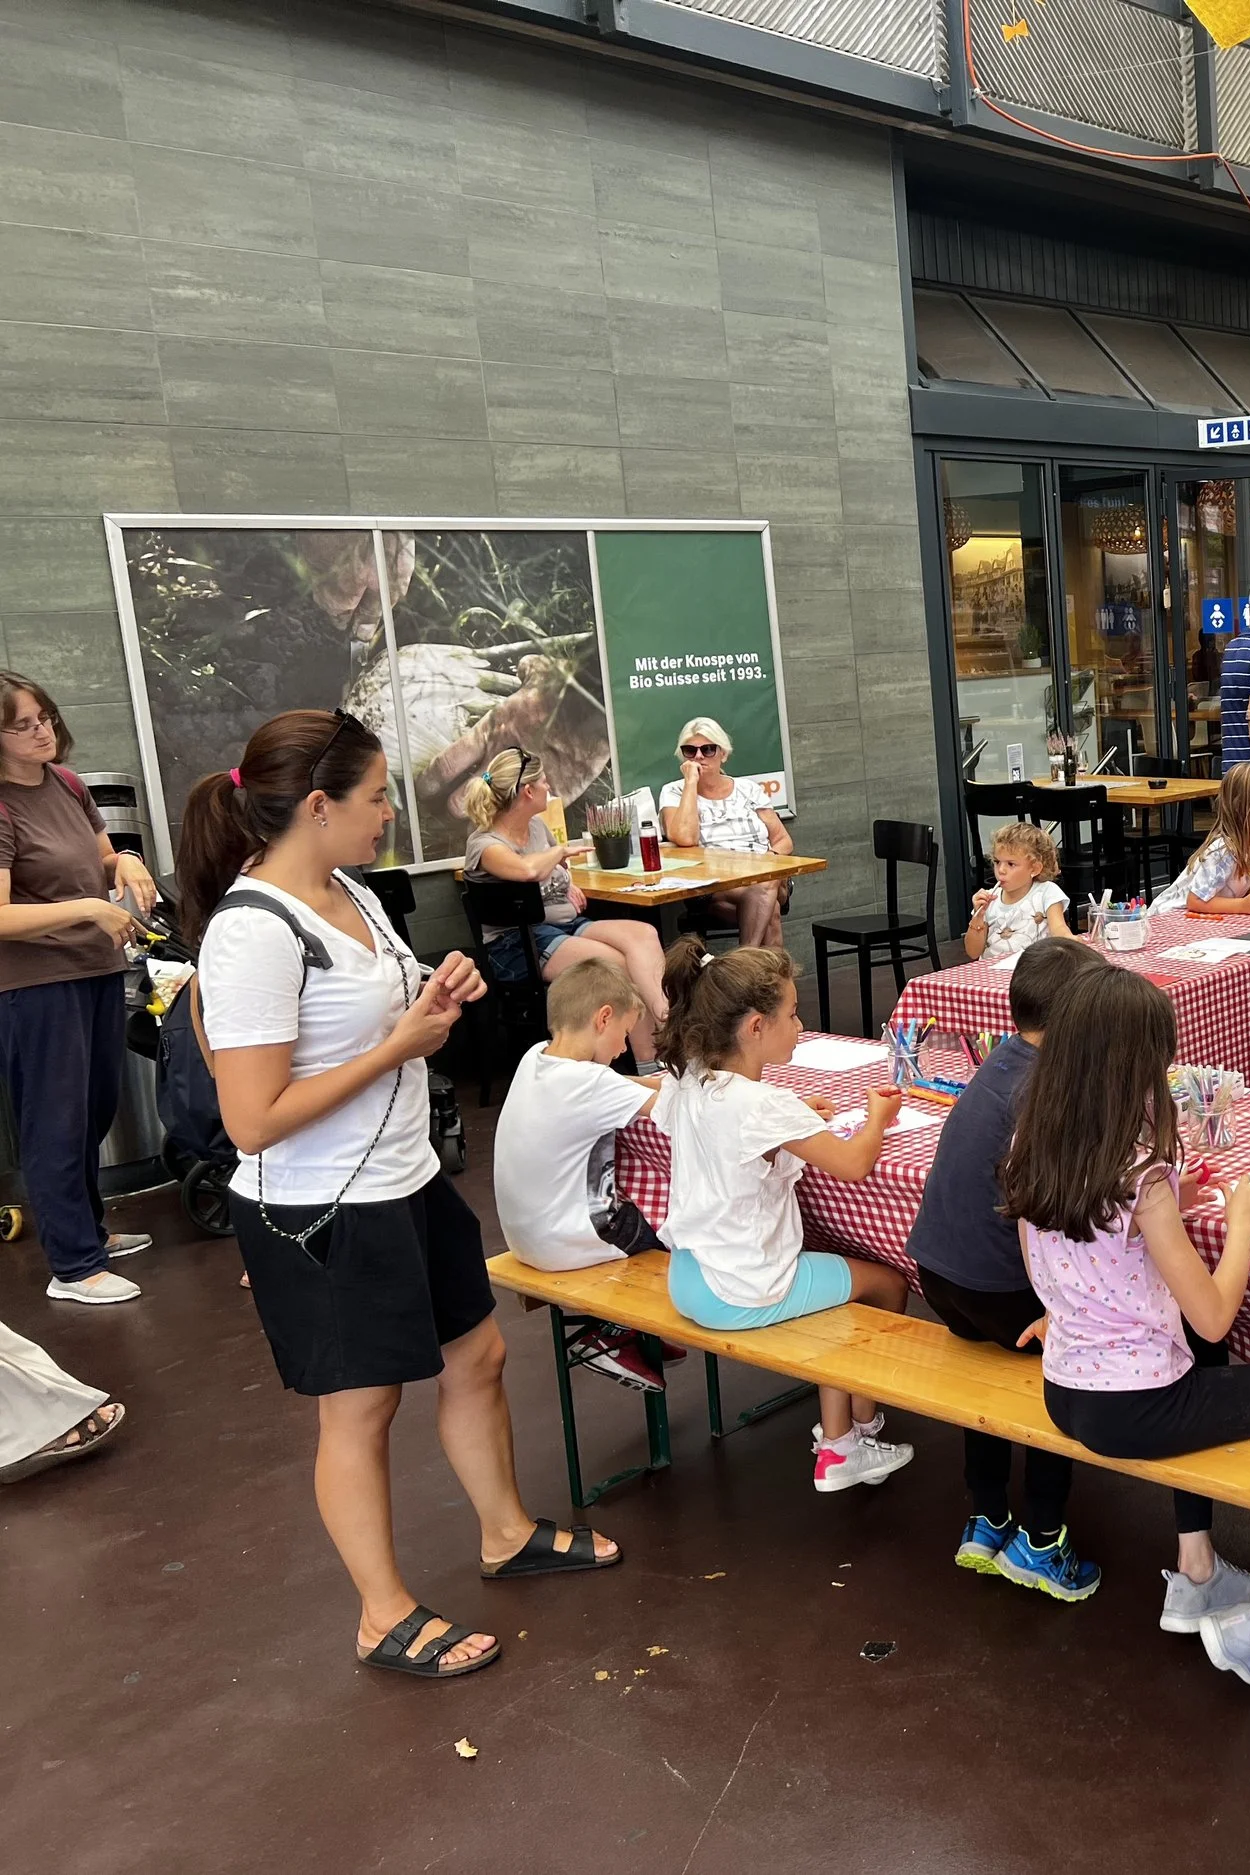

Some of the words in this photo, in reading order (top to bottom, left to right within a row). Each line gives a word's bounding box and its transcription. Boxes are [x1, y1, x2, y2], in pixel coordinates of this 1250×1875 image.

[635, 657, 658, 671] Mit
[660, 656, 683, 670] der
[685, 654, 734, 670] Knospe
[735, 652, 759, 665] von
[629, 674, 653, 689] Bio
[655, 671, 700, 687] Suisse
[702, 669, 727, 683] seit
[729, 666, 767, 681] 1993.
